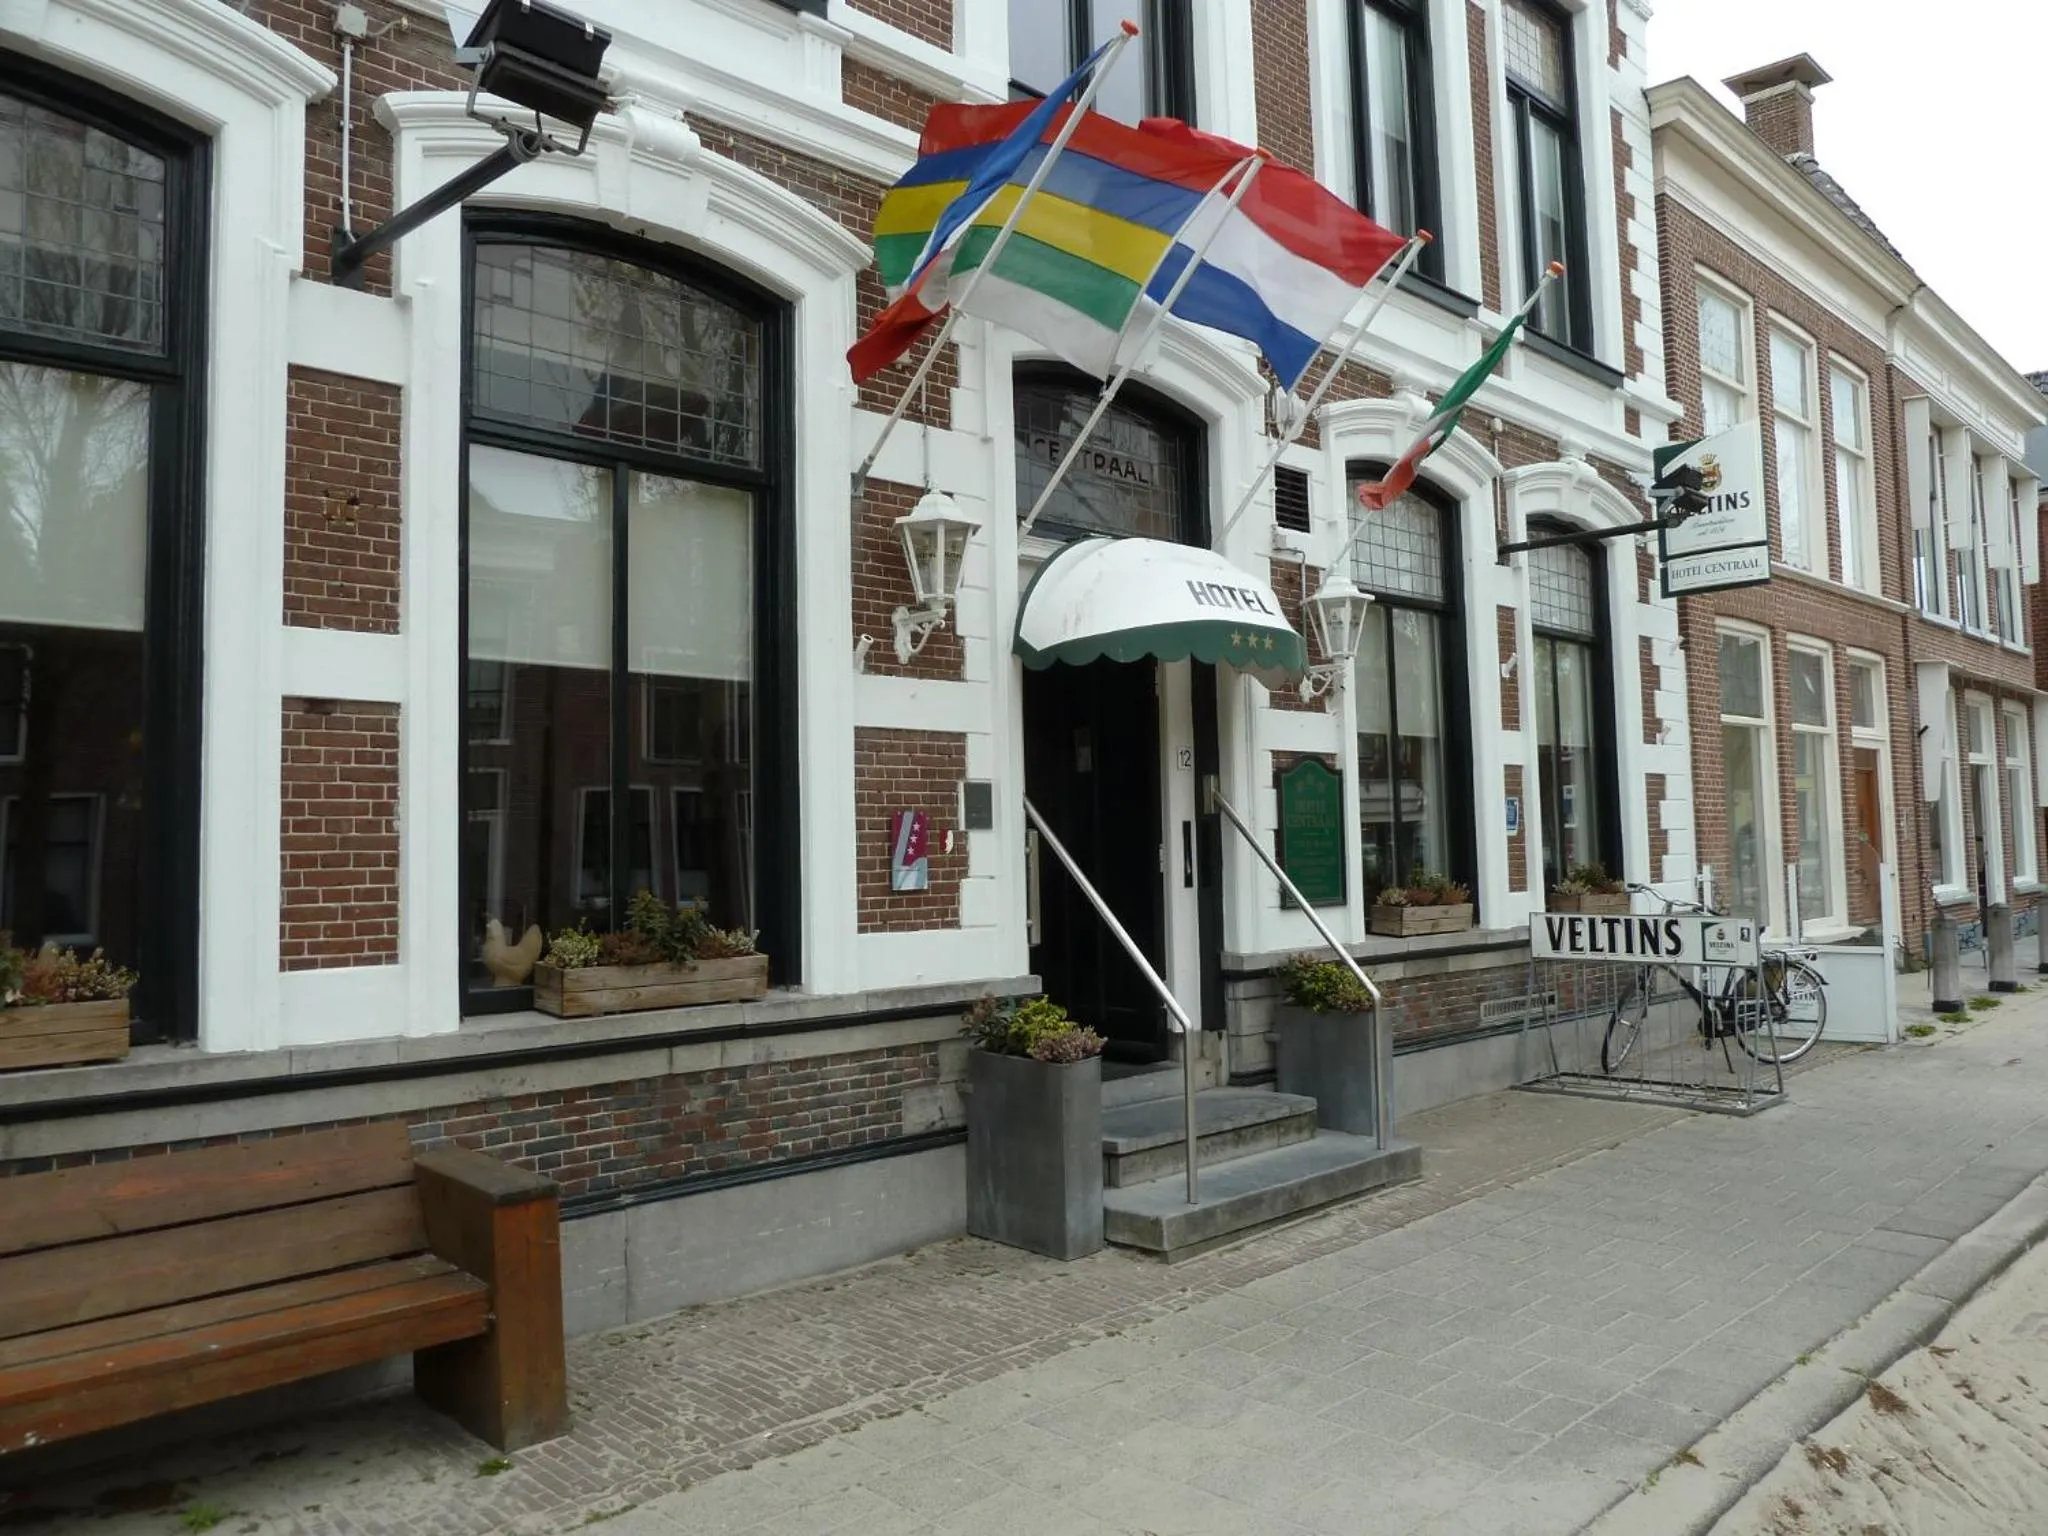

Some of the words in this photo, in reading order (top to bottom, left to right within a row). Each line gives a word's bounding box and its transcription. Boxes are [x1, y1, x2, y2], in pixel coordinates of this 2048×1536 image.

[1034, 438, 1150, 484] CETRAAL
[1690, 490, 1751, 516] TINS
[1671, 567, 1702, 579] HOTEL
[1705, 558, 1760, 574] CENTRAAL
[1185, 579, 1275, 617] HOTEL
[1179, 750, 1192, 767] 12
[1545, 916, 1682, 956] VELTINS
